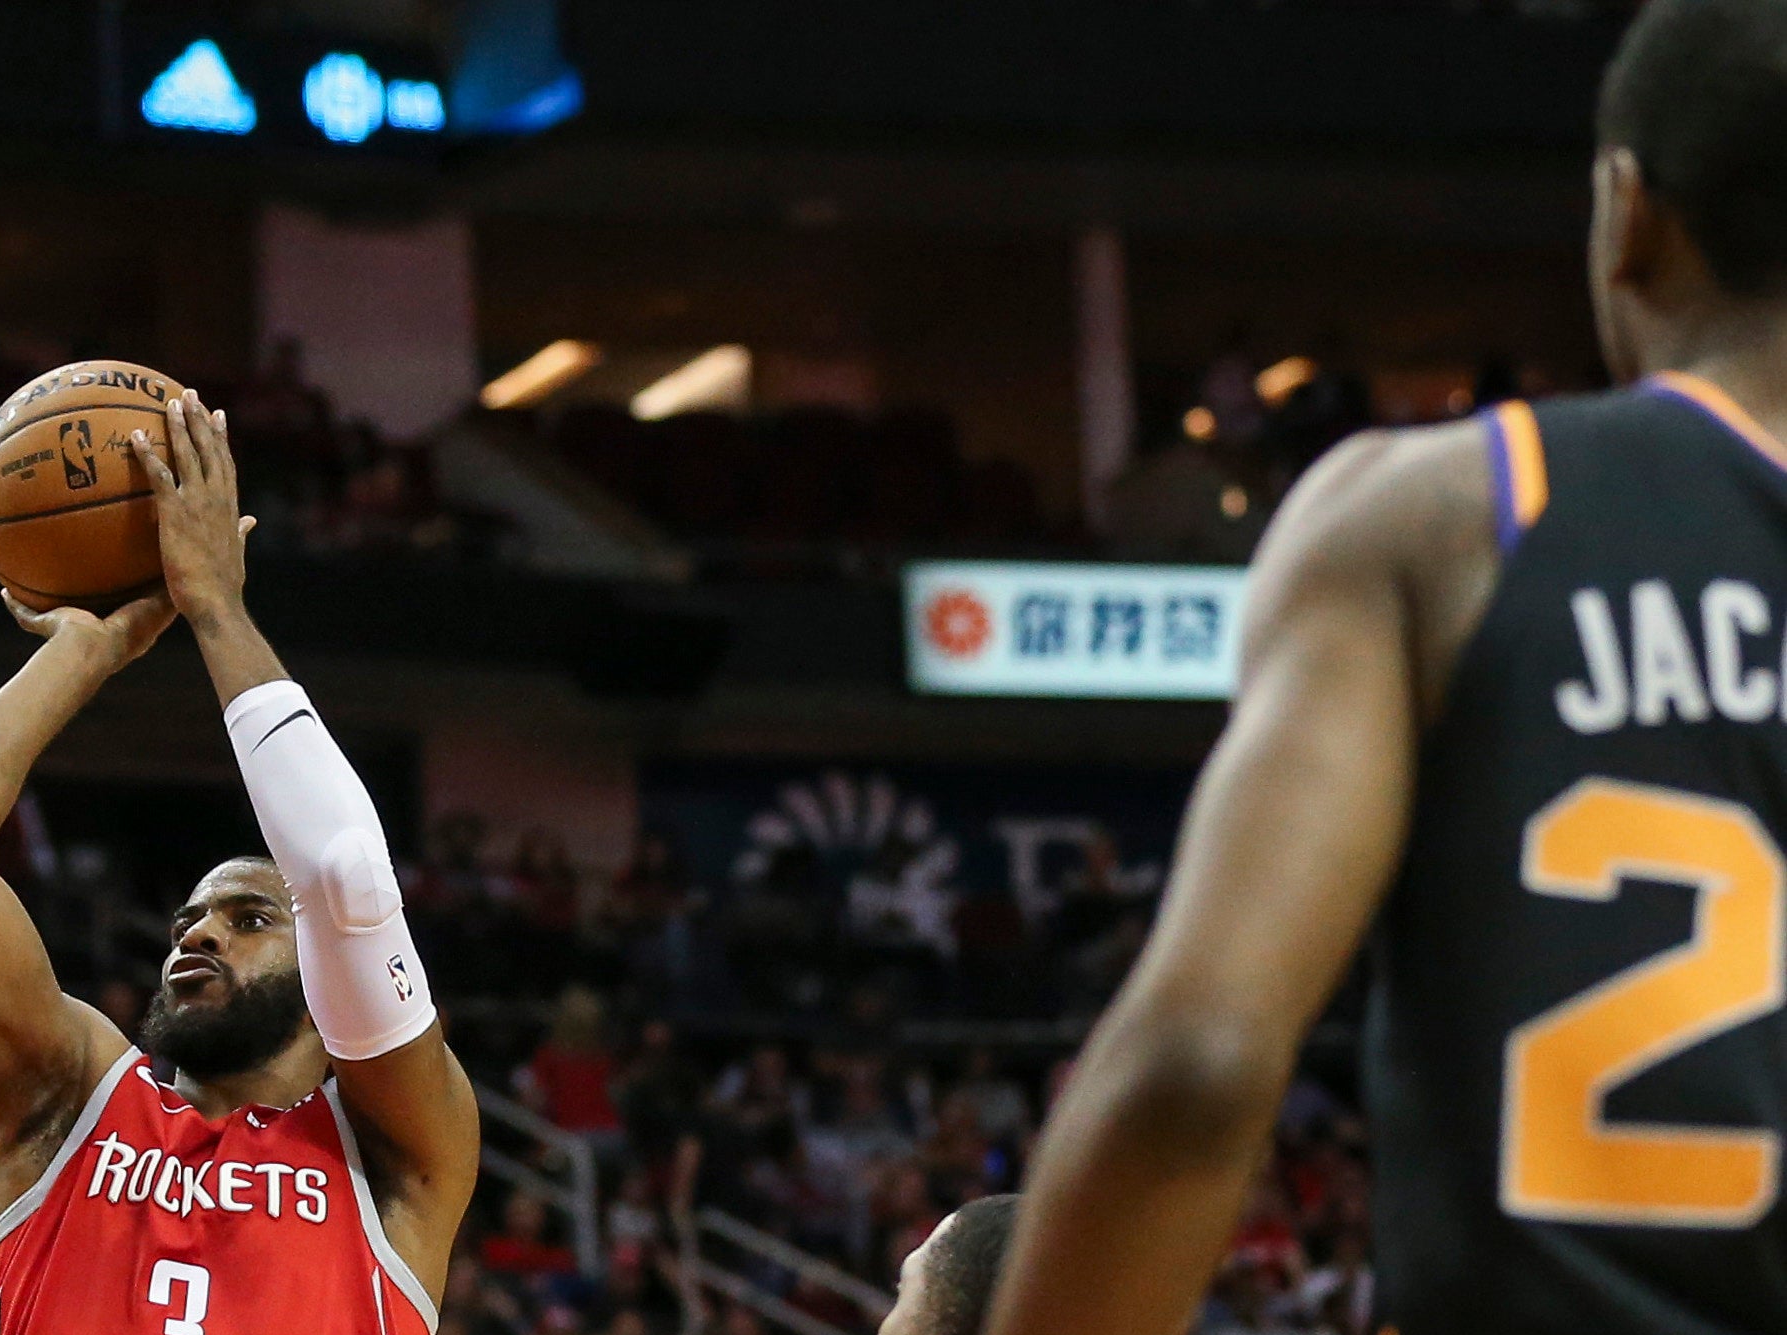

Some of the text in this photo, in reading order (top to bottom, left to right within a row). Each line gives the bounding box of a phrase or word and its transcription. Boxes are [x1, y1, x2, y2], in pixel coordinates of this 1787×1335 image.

[1555, 578, 1787, 735] JAC
[1498, 775, 1786, 1231] 2
[87, 1130, 328, 1224] ROCKETS
